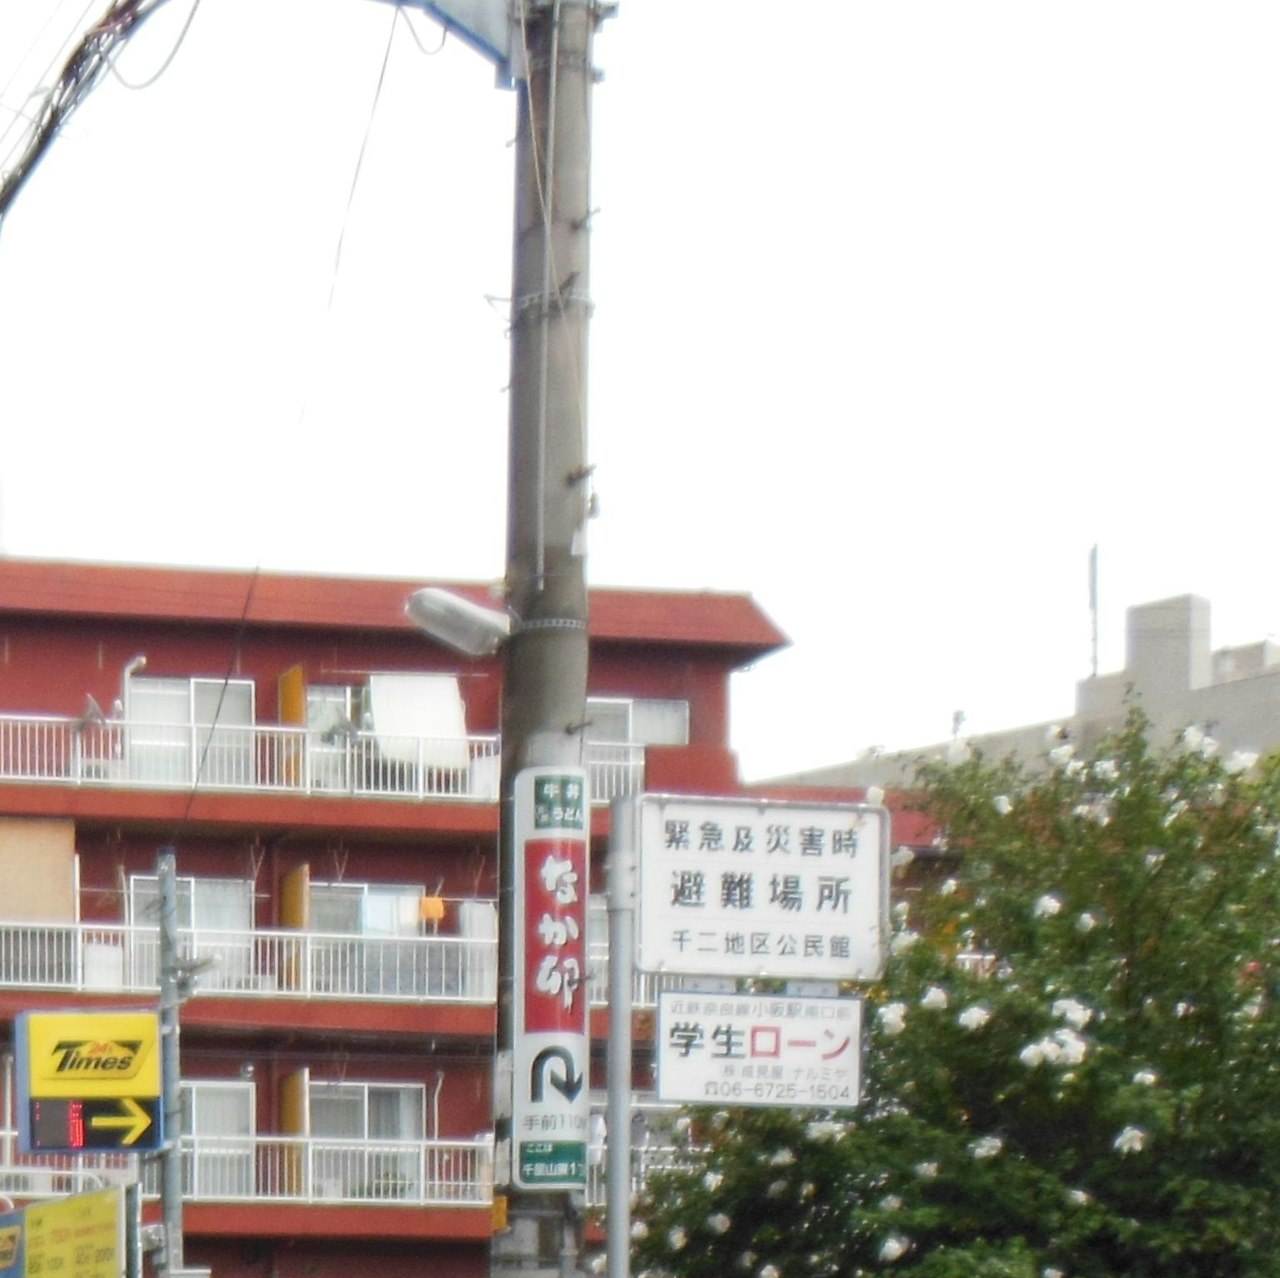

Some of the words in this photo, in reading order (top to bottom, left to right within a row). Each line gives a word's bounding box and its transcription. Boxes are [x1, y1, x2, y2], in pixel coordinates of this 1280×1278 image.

[664, 819, 858, 859] 緊急及災害時
[670, 869, 852, 914] 避難場所
[671, 929, 851, 958] 千二地区公民館
[51, 1040, 142, 1073] Times
[669, 1021, 852, 1061] 学生ローン
